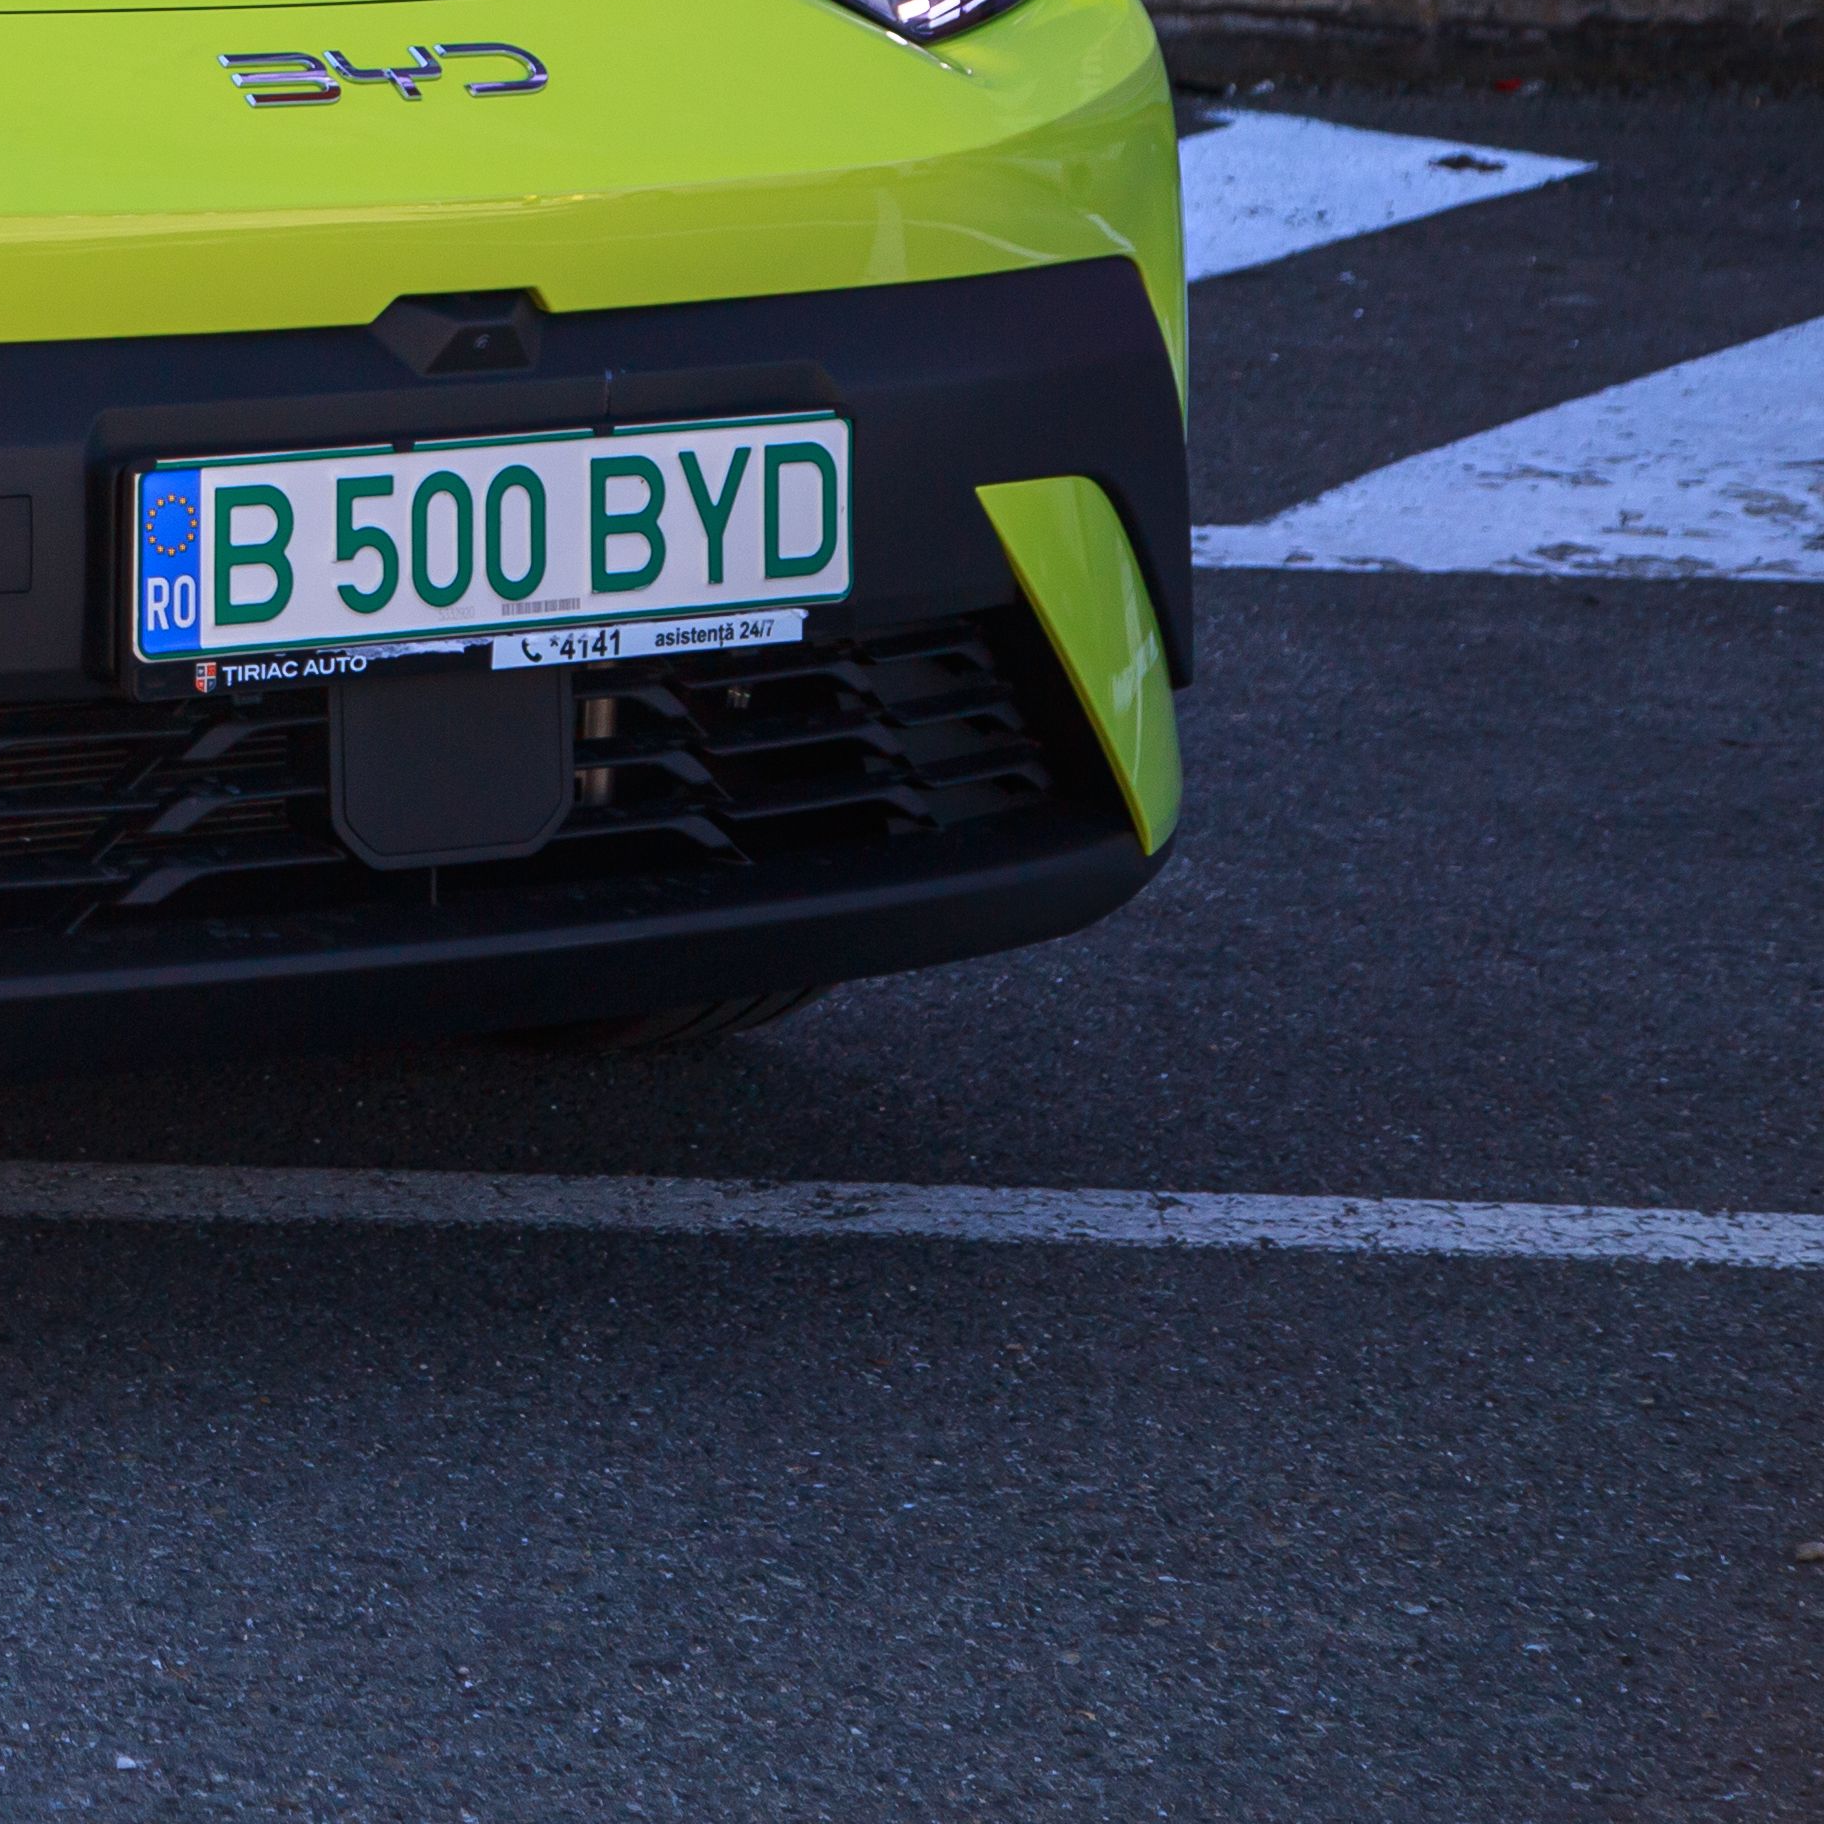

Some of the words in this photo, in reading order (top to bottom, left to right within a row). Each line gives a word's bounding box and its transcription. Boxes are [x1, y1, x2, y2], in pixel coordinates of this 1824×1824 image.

[216, 42, 549, 109] BYD
[212, 483, 294, 627] B
[330, 463, 547, 615] 500
[589, 440, 838, 595] BYD
[147, 575, 196, 632] RO
[739, 619, 775, 640] 24/7
[302, 655, 368, 677] AUTO
